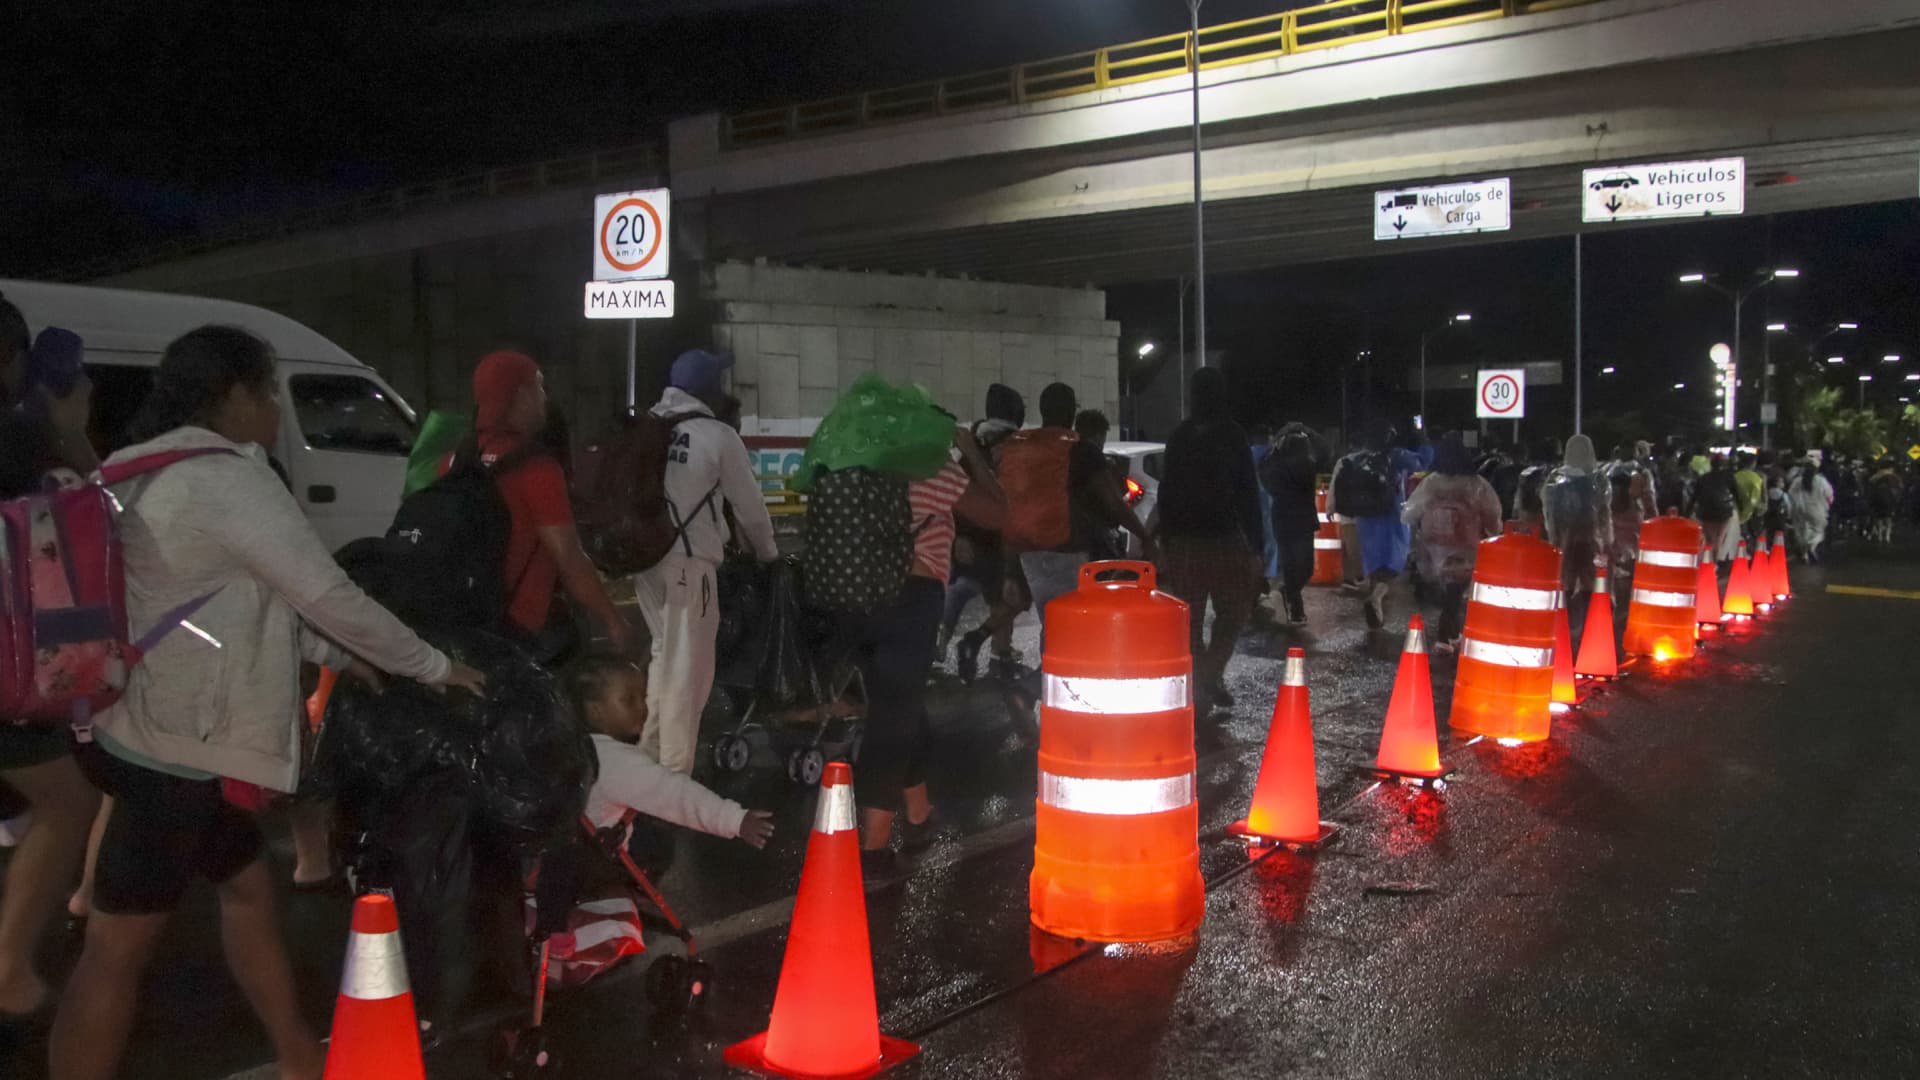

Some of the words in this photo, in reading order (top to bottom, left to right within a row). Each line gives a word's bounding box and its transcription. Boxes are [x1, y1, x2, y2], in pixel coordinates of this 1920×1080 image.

[1647, 167, 1736, 186] Vehiculos
[1421, 189, 1481, 207] Vehiculos
[1487, 186, 1503, 201] de
[1656, 191, 1726, 210] Ligeros
[1445, 210, 1481, 226] Carga
[615, 213, 646, 246] 20
[591, 290, 667, 308] MAXIMA
[1491, 382, 1510, 400] 30
